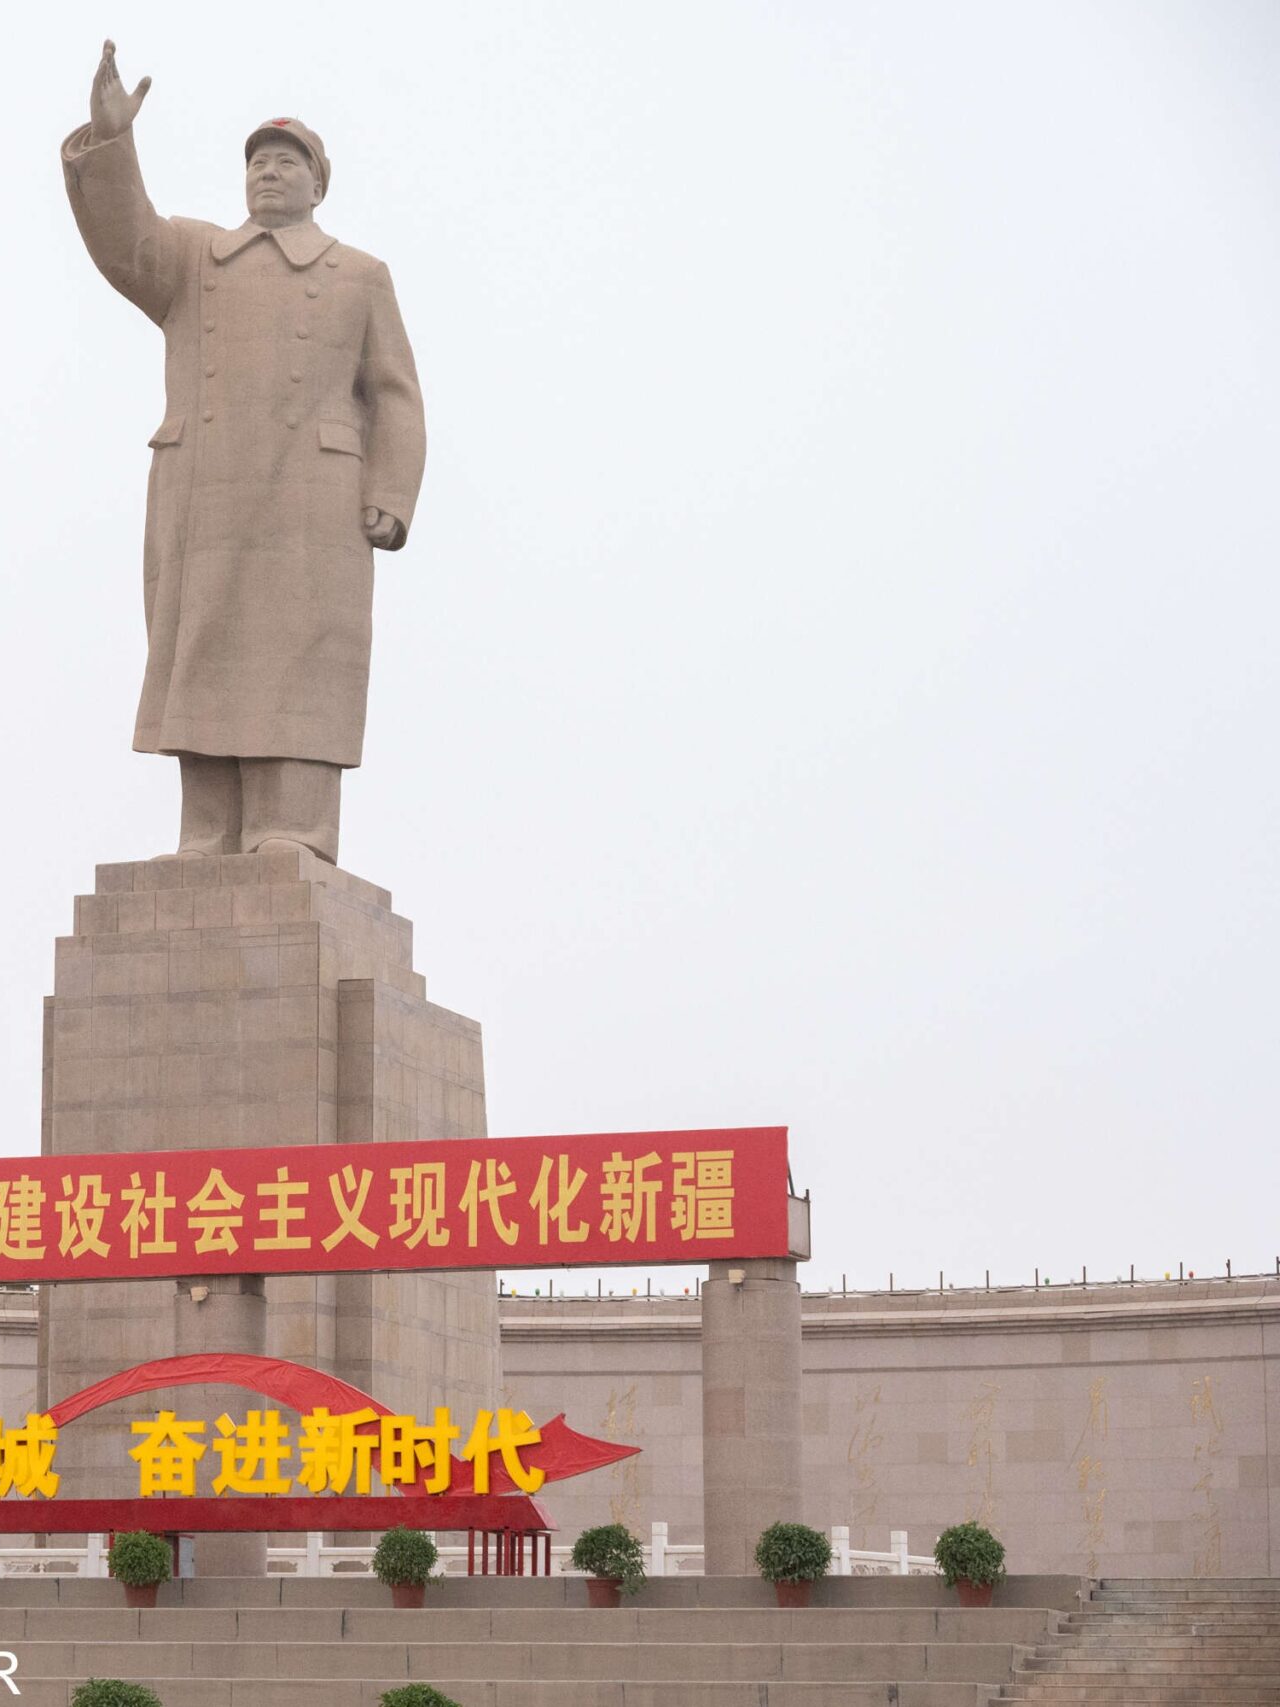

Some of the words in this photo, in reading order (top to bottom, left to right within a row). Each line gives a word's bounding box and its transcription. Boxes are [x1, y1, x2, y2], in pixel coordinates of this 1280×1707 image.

[129, 1407, 545, 1498] 奋进新时代
